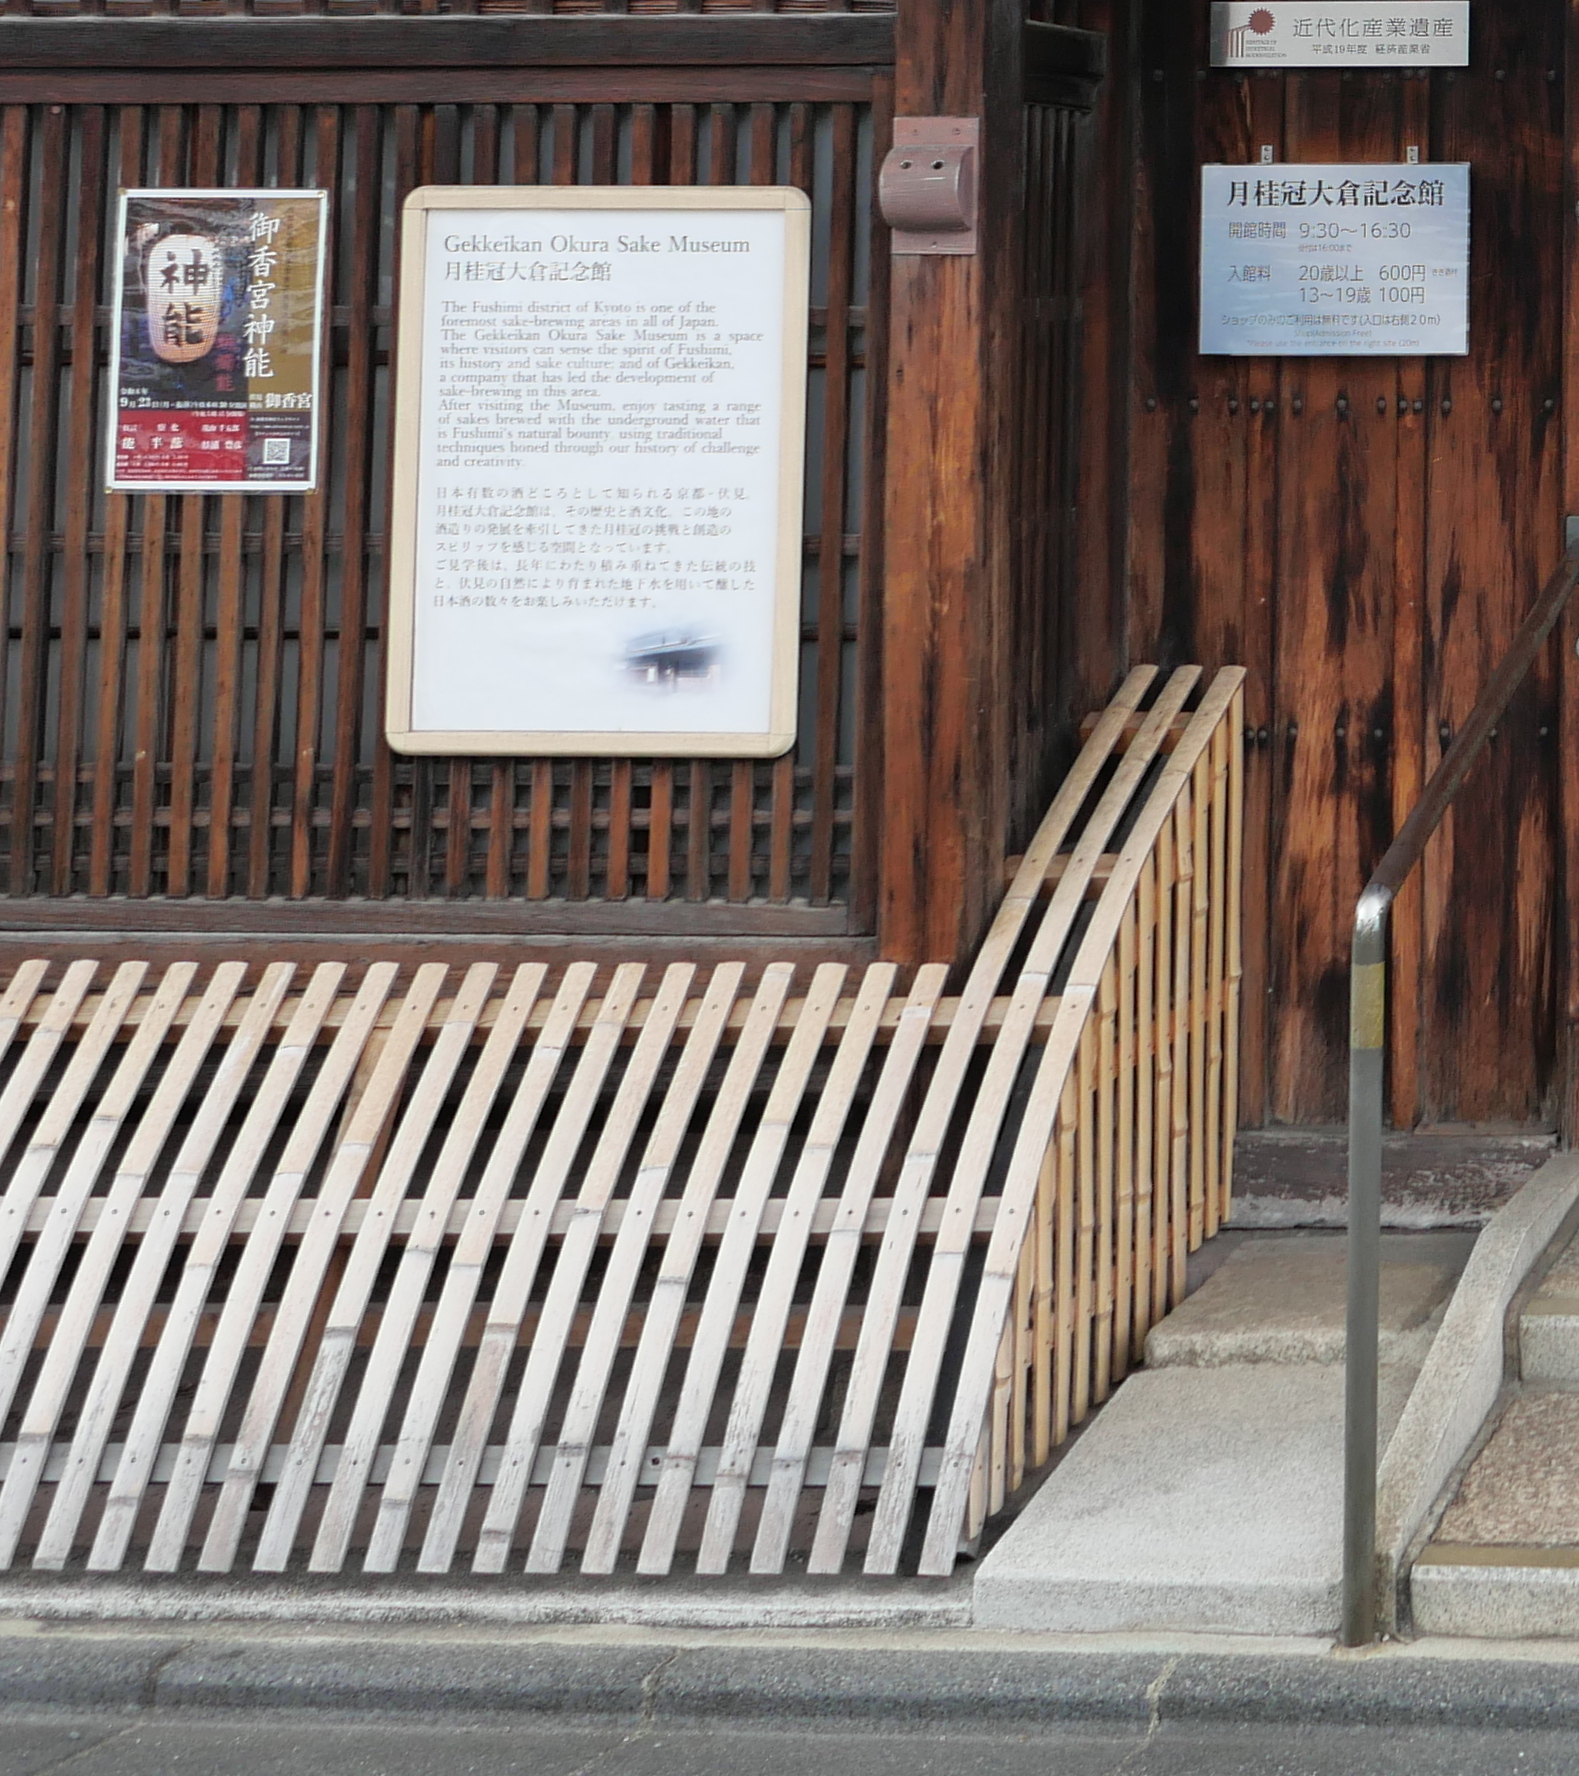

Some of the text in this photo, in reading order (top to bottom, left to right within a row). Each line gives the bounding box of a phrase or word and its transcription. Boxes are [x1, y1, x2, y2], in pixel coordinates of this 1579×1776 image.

[1293, 17, 1454, 38] 近代化産業遺産
[1312, 43, 1368, 55] 平成19年度
[1227, 179, 1444, 207] 月桂冠大倉記念館
[1229, 221, 1286, 239] 開館時間
[444, 234, 750, 253] Gekkeikan Okura Sake Museum
[444, 260, 612, 282] 月桂冠大倉記念館
[1227, 265, 1271, 282] 入館料
[1298, 265, 1364, 282] 20歳以上
[1379, 265, 1426, 282] 600円
[158, 248, 211, 347] 神能
[242, 211, 282, 379] 御香宮神能
[1380, 286, 1426, 303] 100円
[440, 301, 716, 317] The Fushimi district of Kyoto is one of the
[440, 314, 496, 327] foremost
[502, 315, 586, 331] sake-brewing
[588, 318, 622, 327] areas
[626, 317, 638, 328] in
[642, 315, 658, 328] all
[660, 315, 676, 328] of
[440, 328, 764, 345] The Gekkeikan Okura Sake Museum is a space
[440, 342, 478, 355] where
[482, 344, 528, 355] visitors
[532, 346, 554, 355] can
[558, 346, 594, 355] sense
[598, 343, 618, 355] the
[622, 344, 656, 359] spirit
[658, 343, 674, 356] of
[440, 358, 456, 369] its
[458, 356, 504, 372] history
[506, 356, 530, 369] and
[536, 356, 562, 369] sake
[618, 357, 642, 369] and
[646, 357, 662, 369] of
[440, 371, 716, 387] a company that has led the development of
[265, 392, 313, 409] 御香宮
[438, 384, 522, 400] sake-brewing
[526, 386, 538, 397] in
[542, 385, 568, 397] this
[438, 398, 472, 411] After
[478, 400, 524, 415] visiting
[530, 399, 550, 411] the
[622, 401, 656, 415] enjoy
[664, 401, 706, 415] tasting
[712, 403, 720, 412] a
[726, 403, 762, 415] range
[438, 412, 760, 429] of sakes brewed with the underground water that
[438, 428, 448, 439] is
[518, 427, 562, 439] natural
[618, 428, 652, 443] using
[656, 427, 722, 440] traditional
[436, 440, 760, 457] techniques honed through our history of challenge
[434, 454, 460, 467] and
